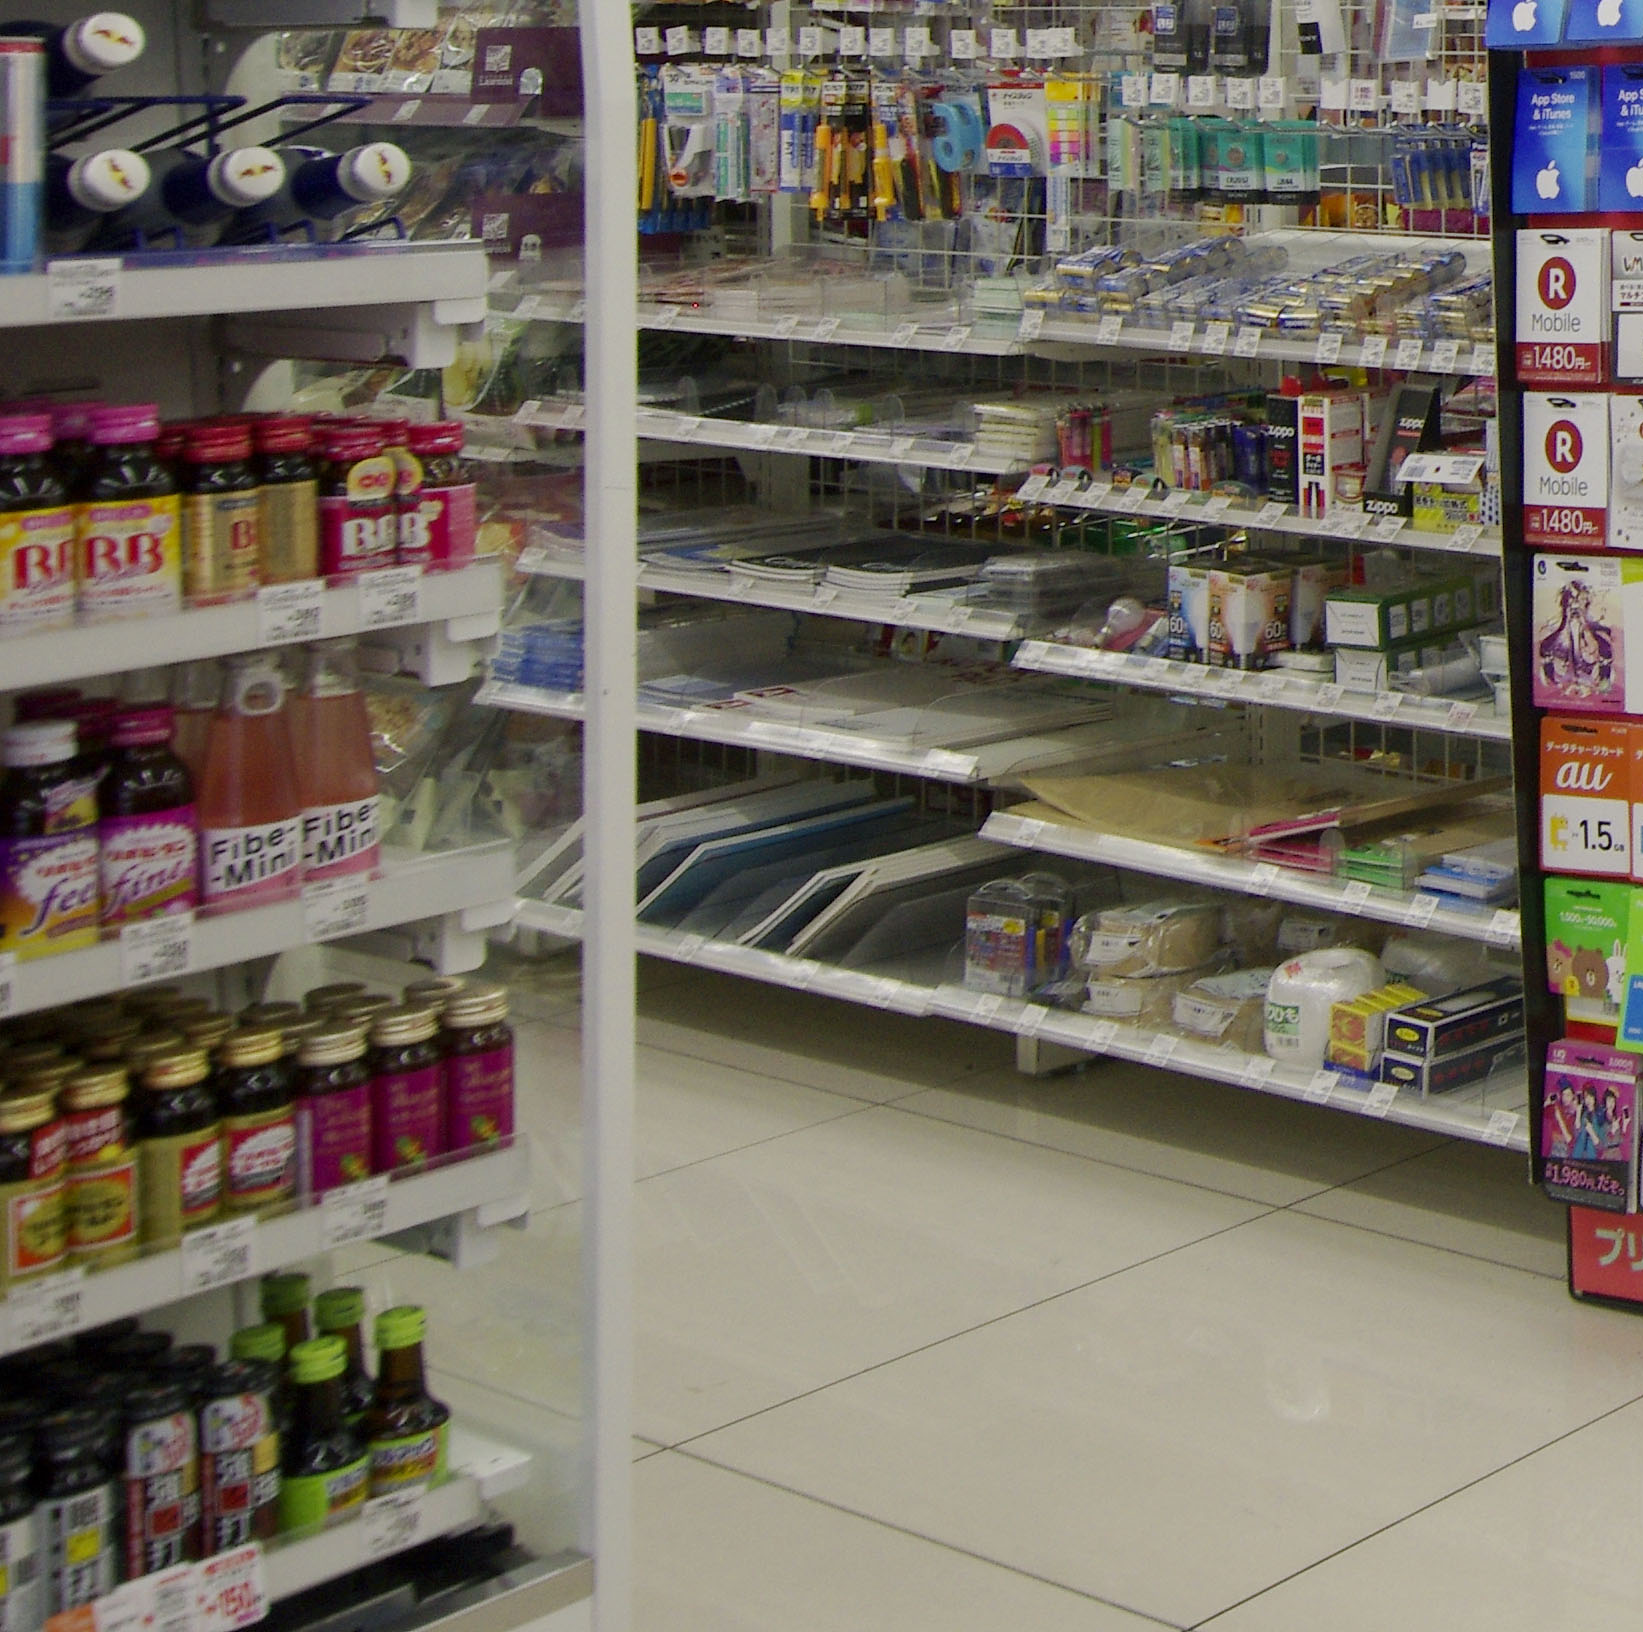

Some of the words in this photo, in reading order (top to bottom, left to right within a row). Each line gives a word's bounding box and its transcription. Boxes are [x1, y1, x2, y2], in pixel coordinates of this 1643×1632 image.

[1530, 94, 1550, 108] App
[1551, 92, 1575, 104] Store
[1617, 90, 1638, 104] App
[1533, 108, 1542, 121] &
[1543, 106, 1572, 120] iTunes
[1620, 104, 1630, 117] &
[1548, 267, 1567, 300] R
[1531, 312, 1582, 334] Mobile
[1556, 431, 1573, 464] R
[1539, 474, 1589, 497] Mobile
[1365, 497, 1399, 515] zippo
[1545, 741, 1624, 757] データチャージカード
[1556, 761, 1614, 793] au
[302, 794, 381, 842] Fibe-
[209, 826, 296, 866] Fibe-
[1579, 819, 1613, 852] 1.5
